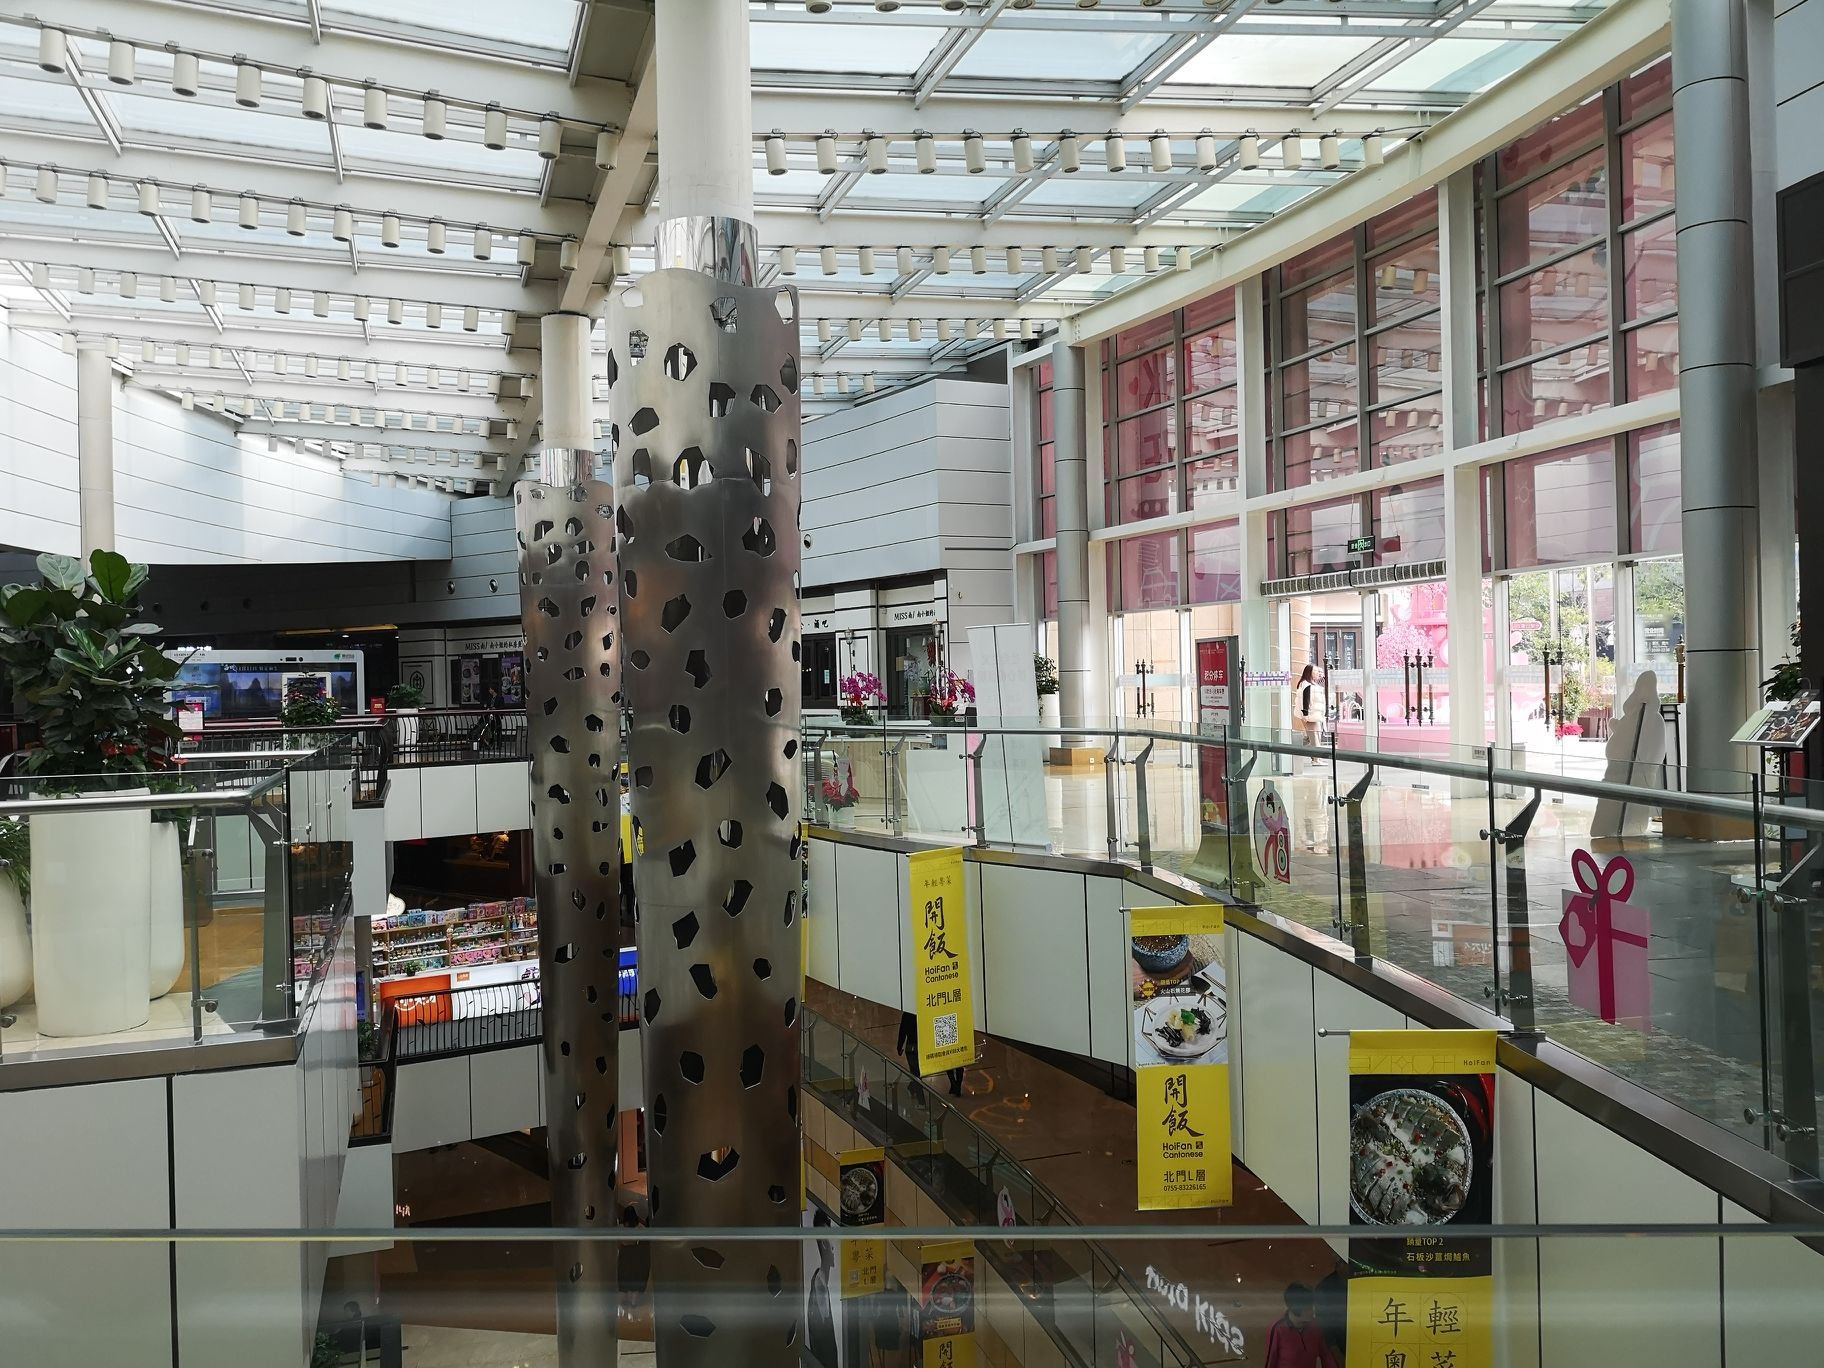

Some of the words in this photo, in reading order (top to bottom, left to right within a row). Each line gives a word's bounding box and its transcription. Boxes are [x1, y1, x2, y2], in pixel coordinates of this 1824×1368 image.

[924, 896, 959, 961] 開飯
[924, 964, 951, 976] HoiFan
[925, 972, 959, 984] Cantonese
[926, 988, 962, 1007] 北門L層
[1162, 1074, 1204, 1137] 開飯
[1162, 1142, 1193, 1151] HoiFan
[1162, 1151, 1204, 1159] Cantonese
[1163, 1169, 1206, 1183] 北門L層
